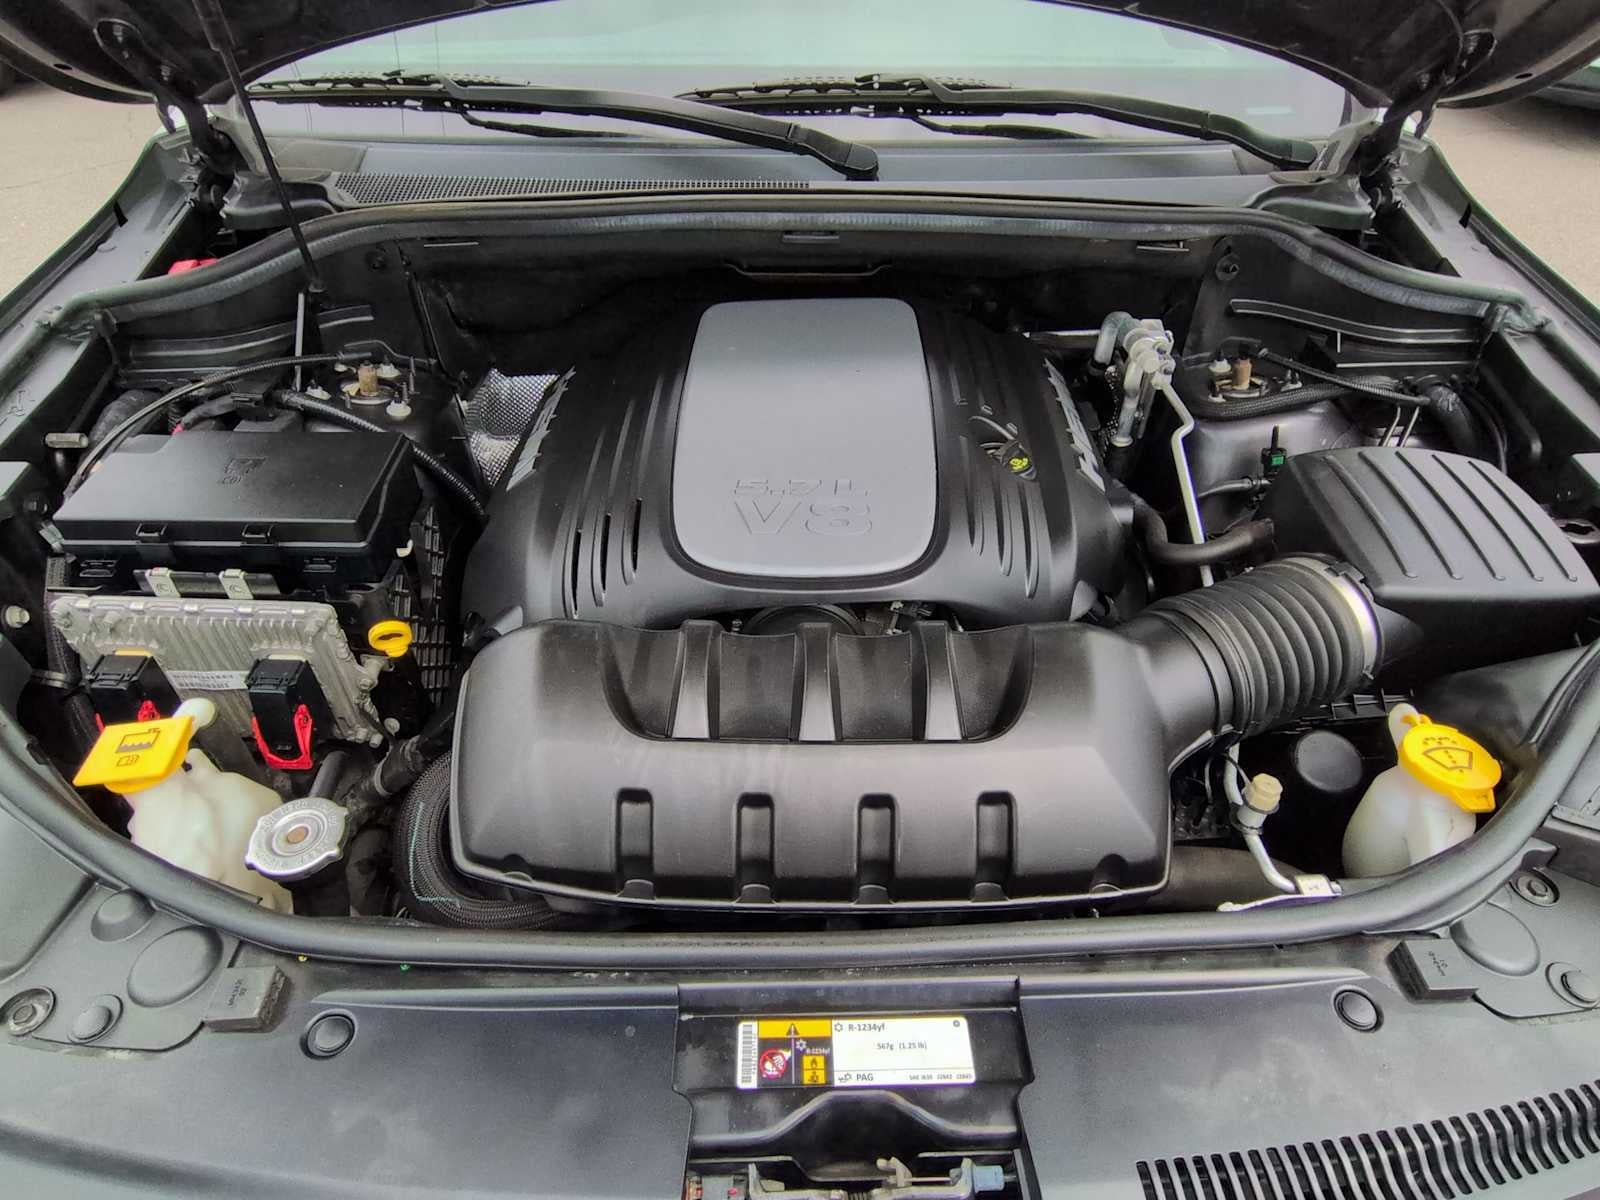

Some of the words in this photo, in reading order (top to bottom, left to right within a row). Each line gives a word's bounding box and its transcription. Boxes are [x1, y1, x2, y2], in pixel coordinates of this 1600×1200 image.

[734, 479, 869, 496] 5.7L
[733, 499, 873, 536] V8
[848, 1022, 886, 1033] R-1234yf
[876, 1042, 894, 1051] 567g
[898, 1041, 917, 1050] (1.25
[918, 1040, 928, 1050] lb)
[856, 1072, 874, 1081] PAG
